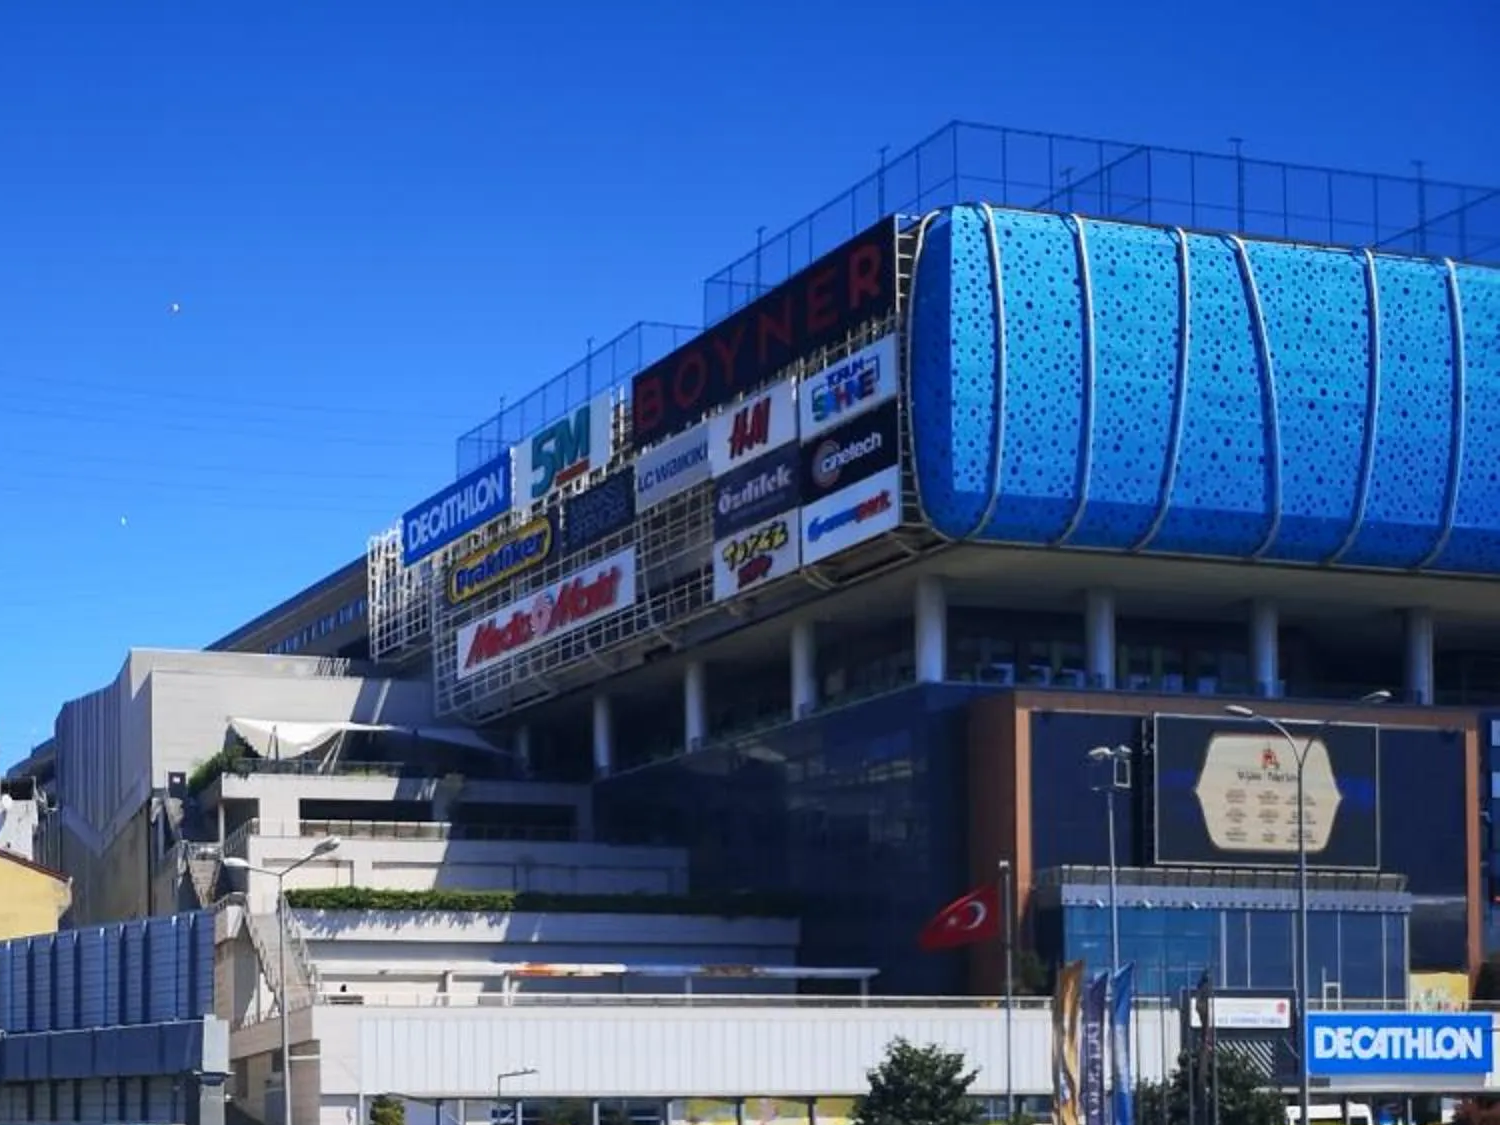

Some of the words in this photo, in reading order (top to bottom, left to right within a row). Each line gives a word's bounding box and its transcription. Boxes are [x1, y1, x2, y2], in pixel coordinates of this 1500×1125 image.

[634, 243, 883, 434] BOYNER
[407, 465, 505, 550] DECATHLON
[1313, 1025, 1484, 1061] DECATHLON
